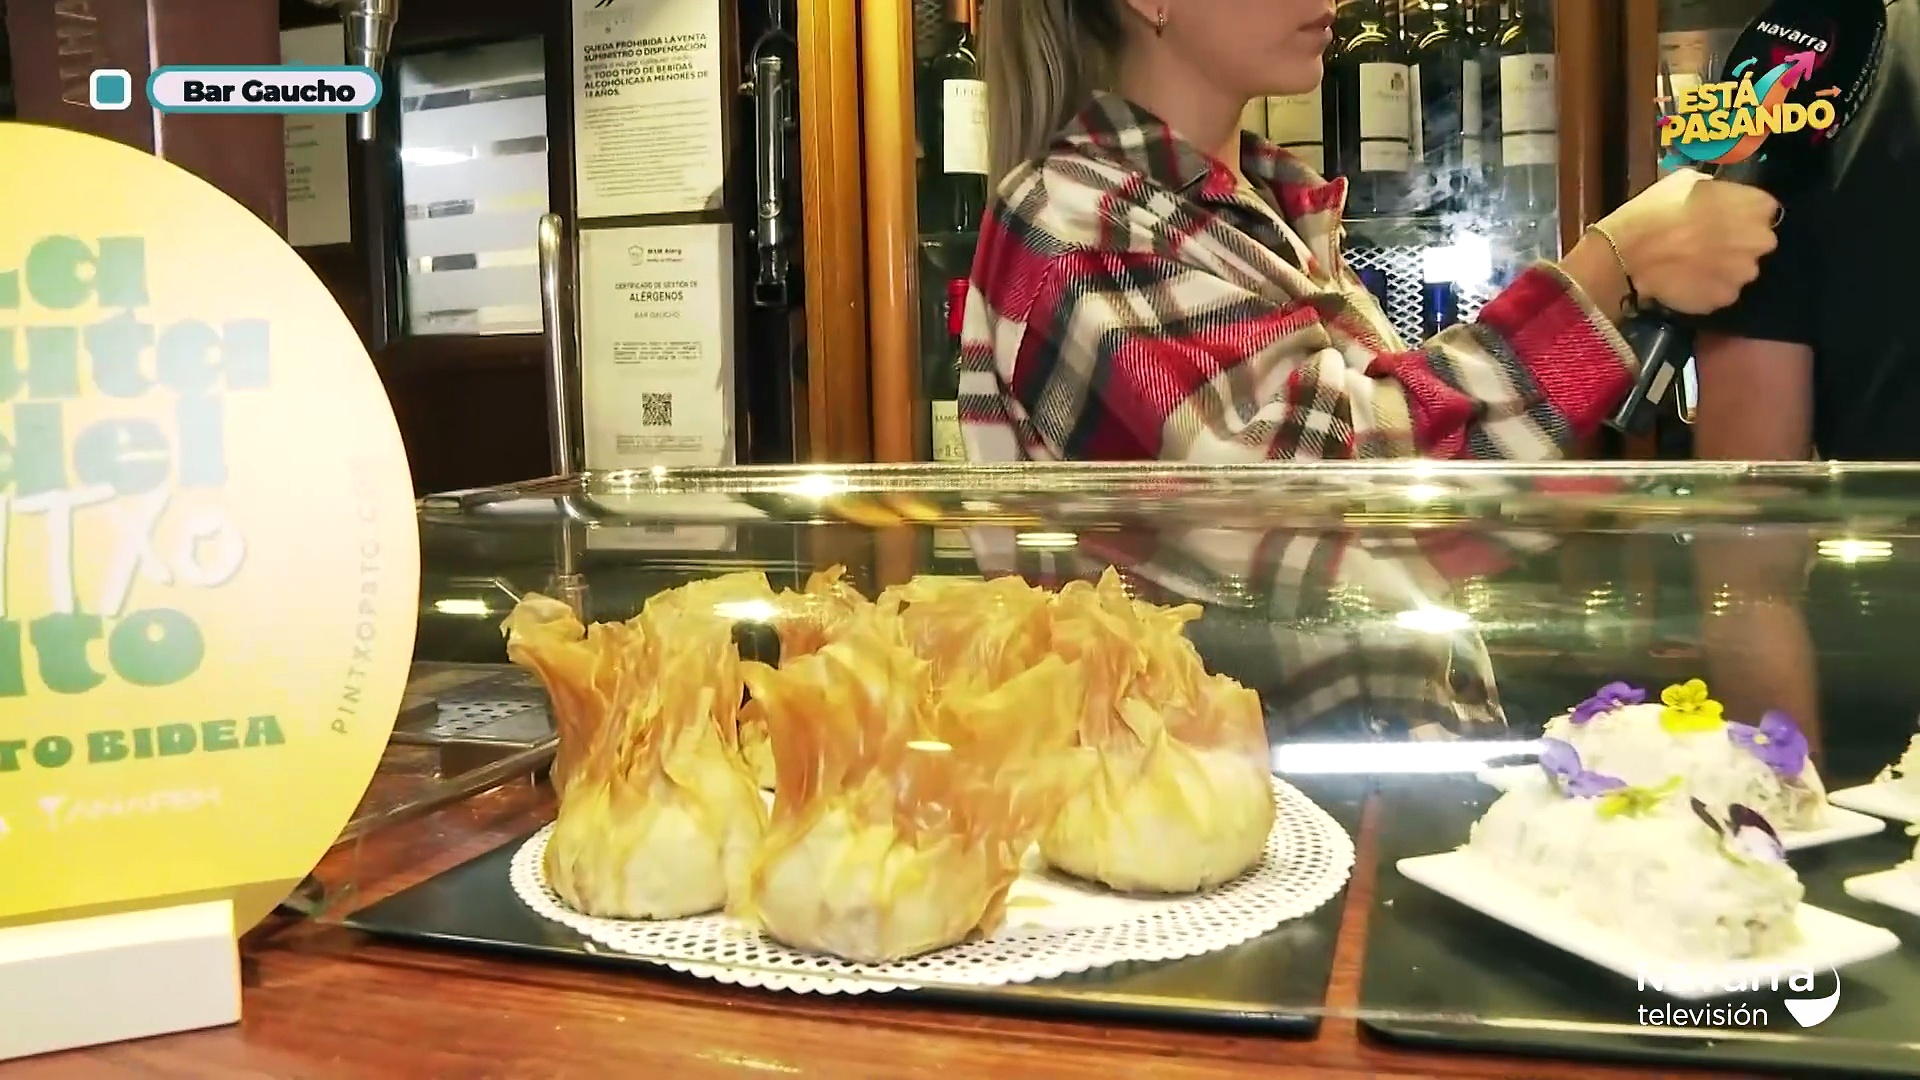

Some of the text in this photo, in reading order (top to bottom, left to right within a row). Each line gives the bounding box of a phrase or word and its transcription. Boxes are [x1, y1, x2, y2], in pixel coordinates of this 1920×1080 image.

[584, 32, 707, 54] QUEDA PROHIBIDA LA VENTA
[1756, 20, 1828, 53] Navarra
[584, 49, 634, 62] SUMINISTRO
[635, 49, 643, 57] O
[595, 69, 620, 79] TODO
[620, 67, 641, 76] TIPO
[642, 65, 654, 75] DE
[656, 62, 693, 73] BEBIDAS
[646, 75, 653, 83] A
[654, 71, 696, 82] MENORES
[697, 70, 709, 79] DE
[0, 234, 150, 310] a
[87, 714, 287, 764] BIDEA
